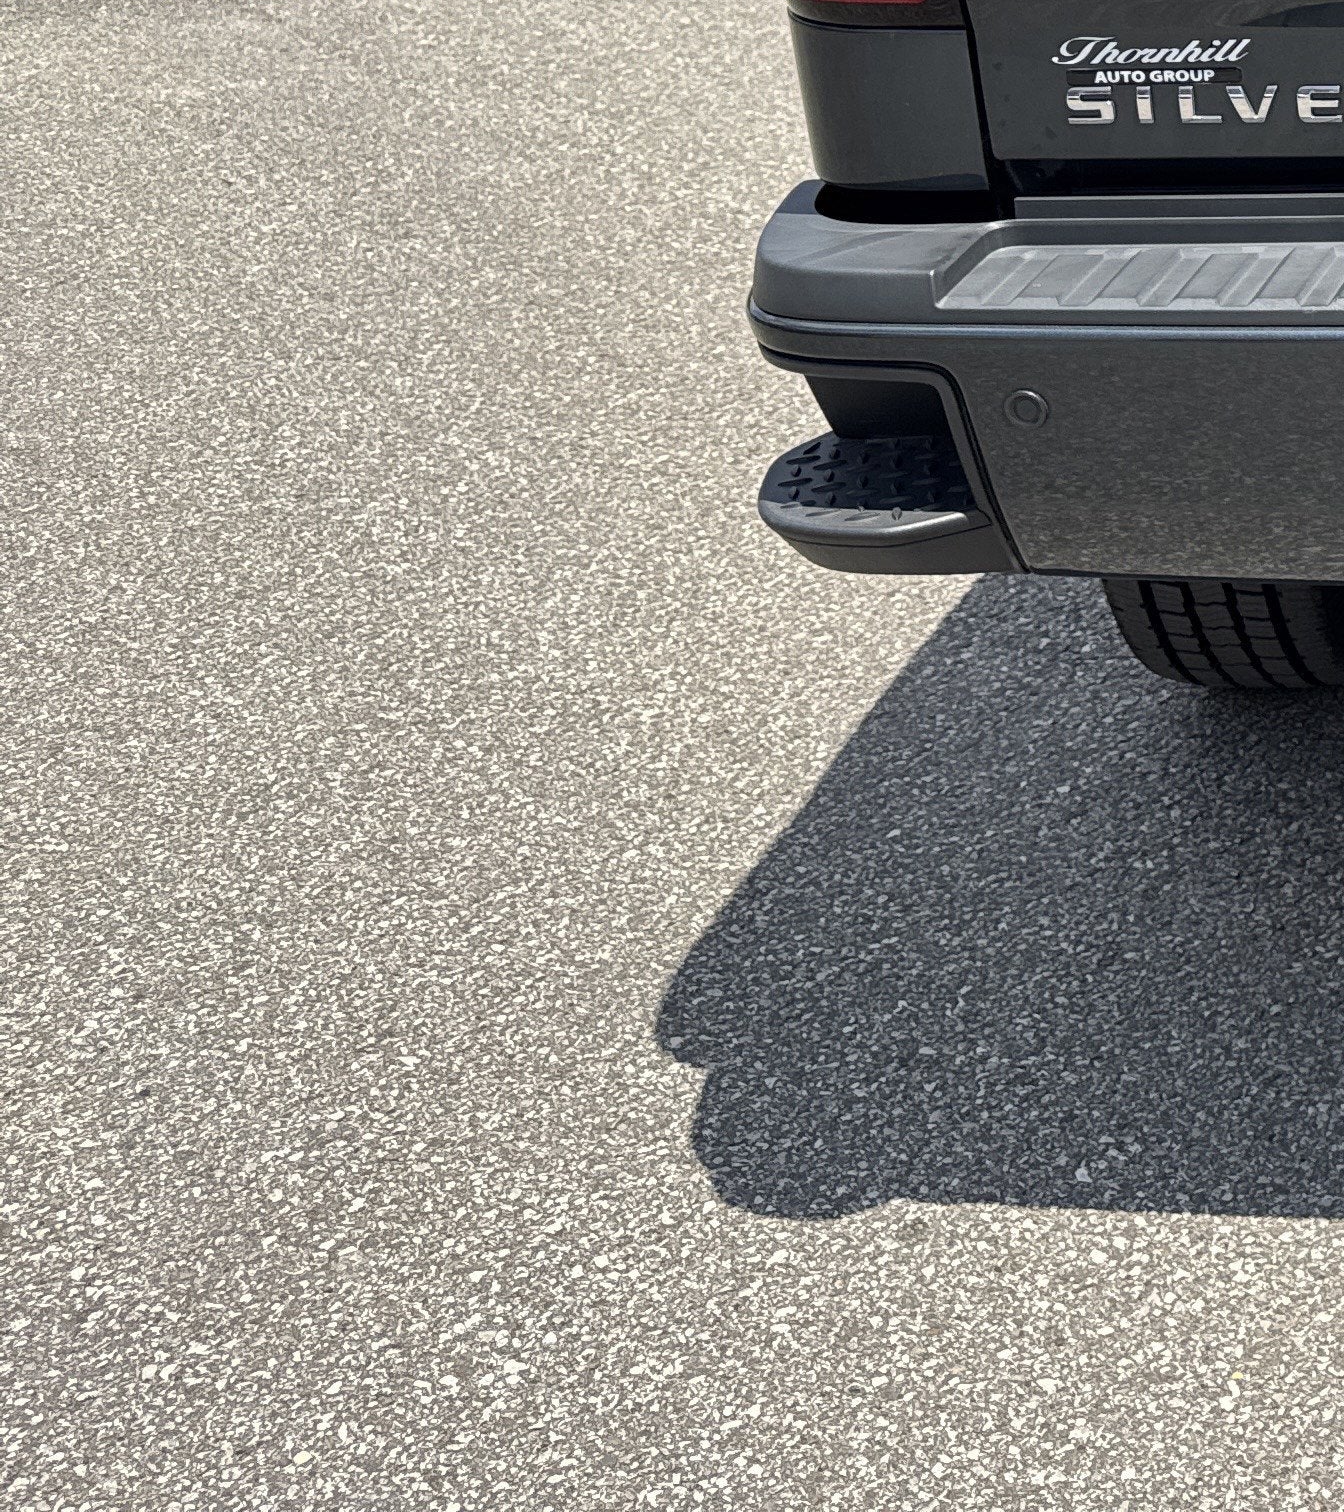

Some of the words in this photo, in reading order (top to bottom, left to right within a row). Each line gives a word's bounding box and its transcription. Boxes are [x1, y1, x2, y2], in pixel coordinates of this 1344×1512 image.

[1051, 36, 1250, 65] Thornhill
[1094, 70, 1145, 84] AUTO
[1149, 69, 1215, 83] GROUP
